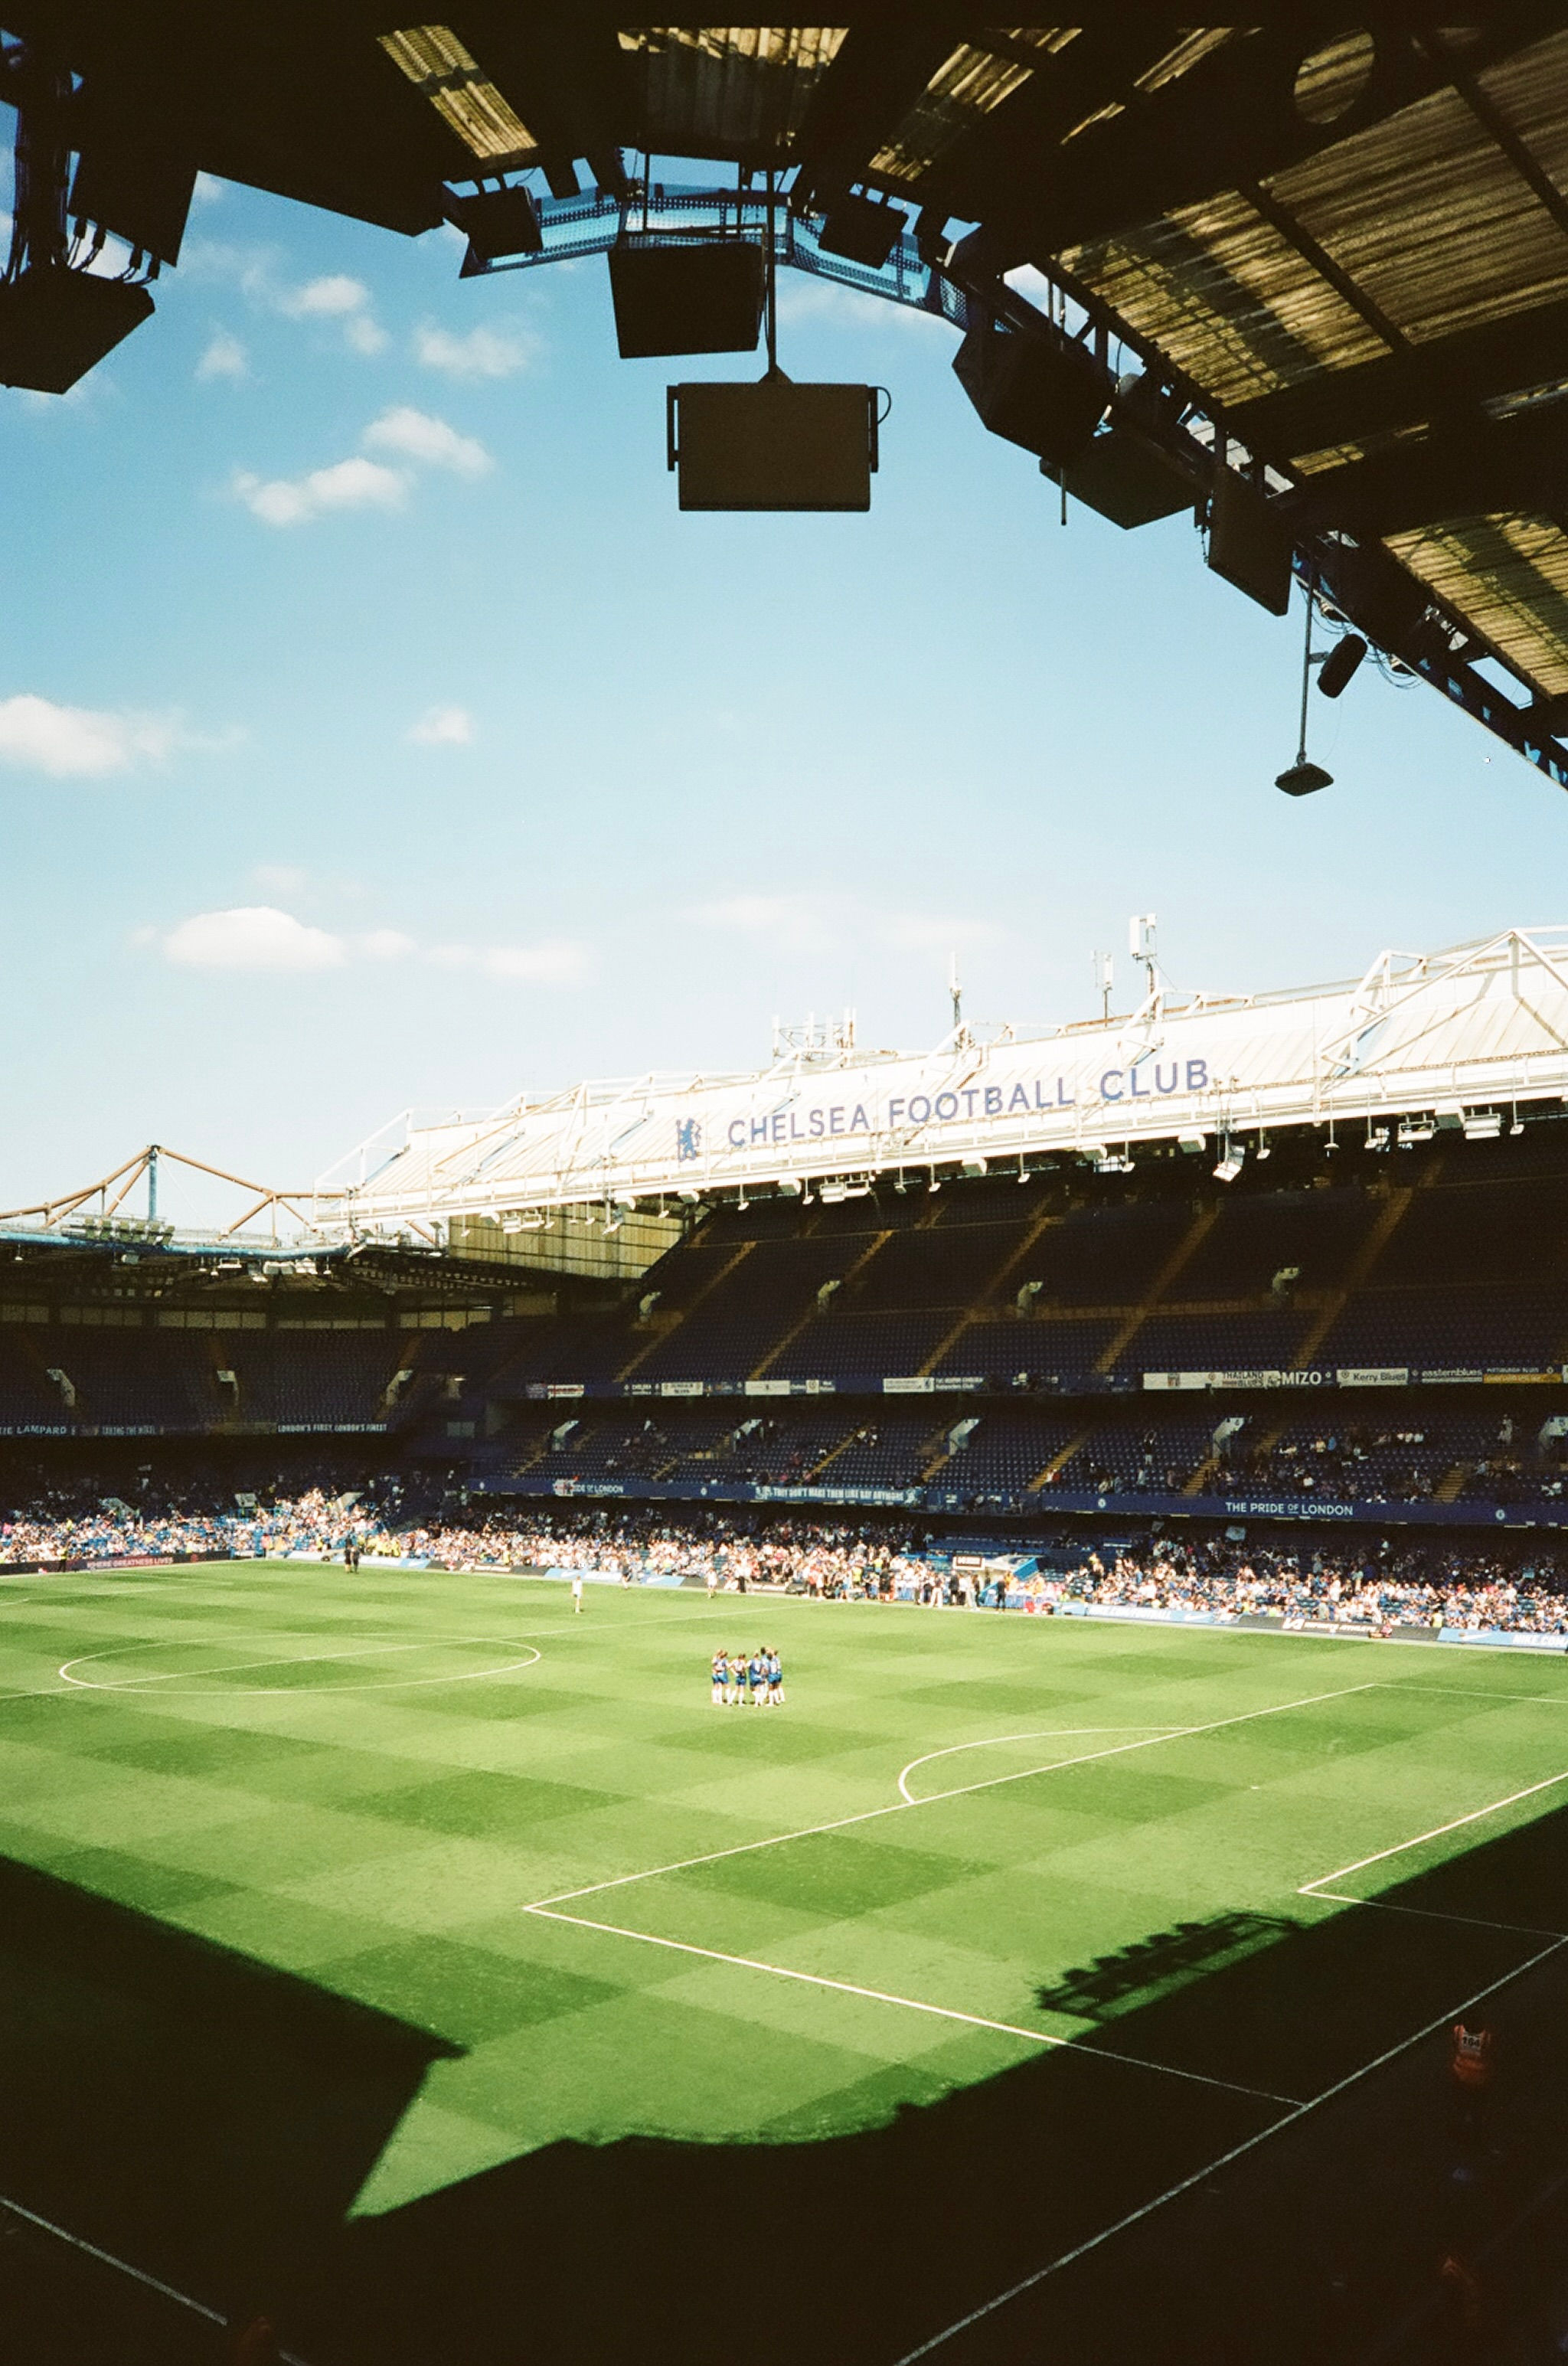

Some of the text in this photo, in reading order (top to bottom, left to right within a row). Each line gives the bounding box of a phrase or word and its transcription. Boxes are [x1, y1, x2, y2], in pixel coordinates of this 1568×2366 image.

[727, 1059, 1210, 1146] CHELSEA FOOTBALL CLUB
[1223, 1371, 1263, 1379] THAILAND
[1353, 1371, 1406, 1381] Kerry Blues
[1421, 1368, 1482, 1377] easternblues
[1282, 1371, 1322, 1385] MIZO
[17, 1425, 67, 1435] LAMPARD
[278, 1424, 311, 1433] LONDON'S
[335, 1423, 364, 1432] LONDON'S
[594, 1485, 624, 1493] LONDON
[827, 1489, 844, 1498] THEM
[844, 1490, 858, 1499] LIKE
[1225, 1502, 1354, 1515] THE PRIDE OF LONDON
[113, 1557, 152, 1567] GREATNESS
